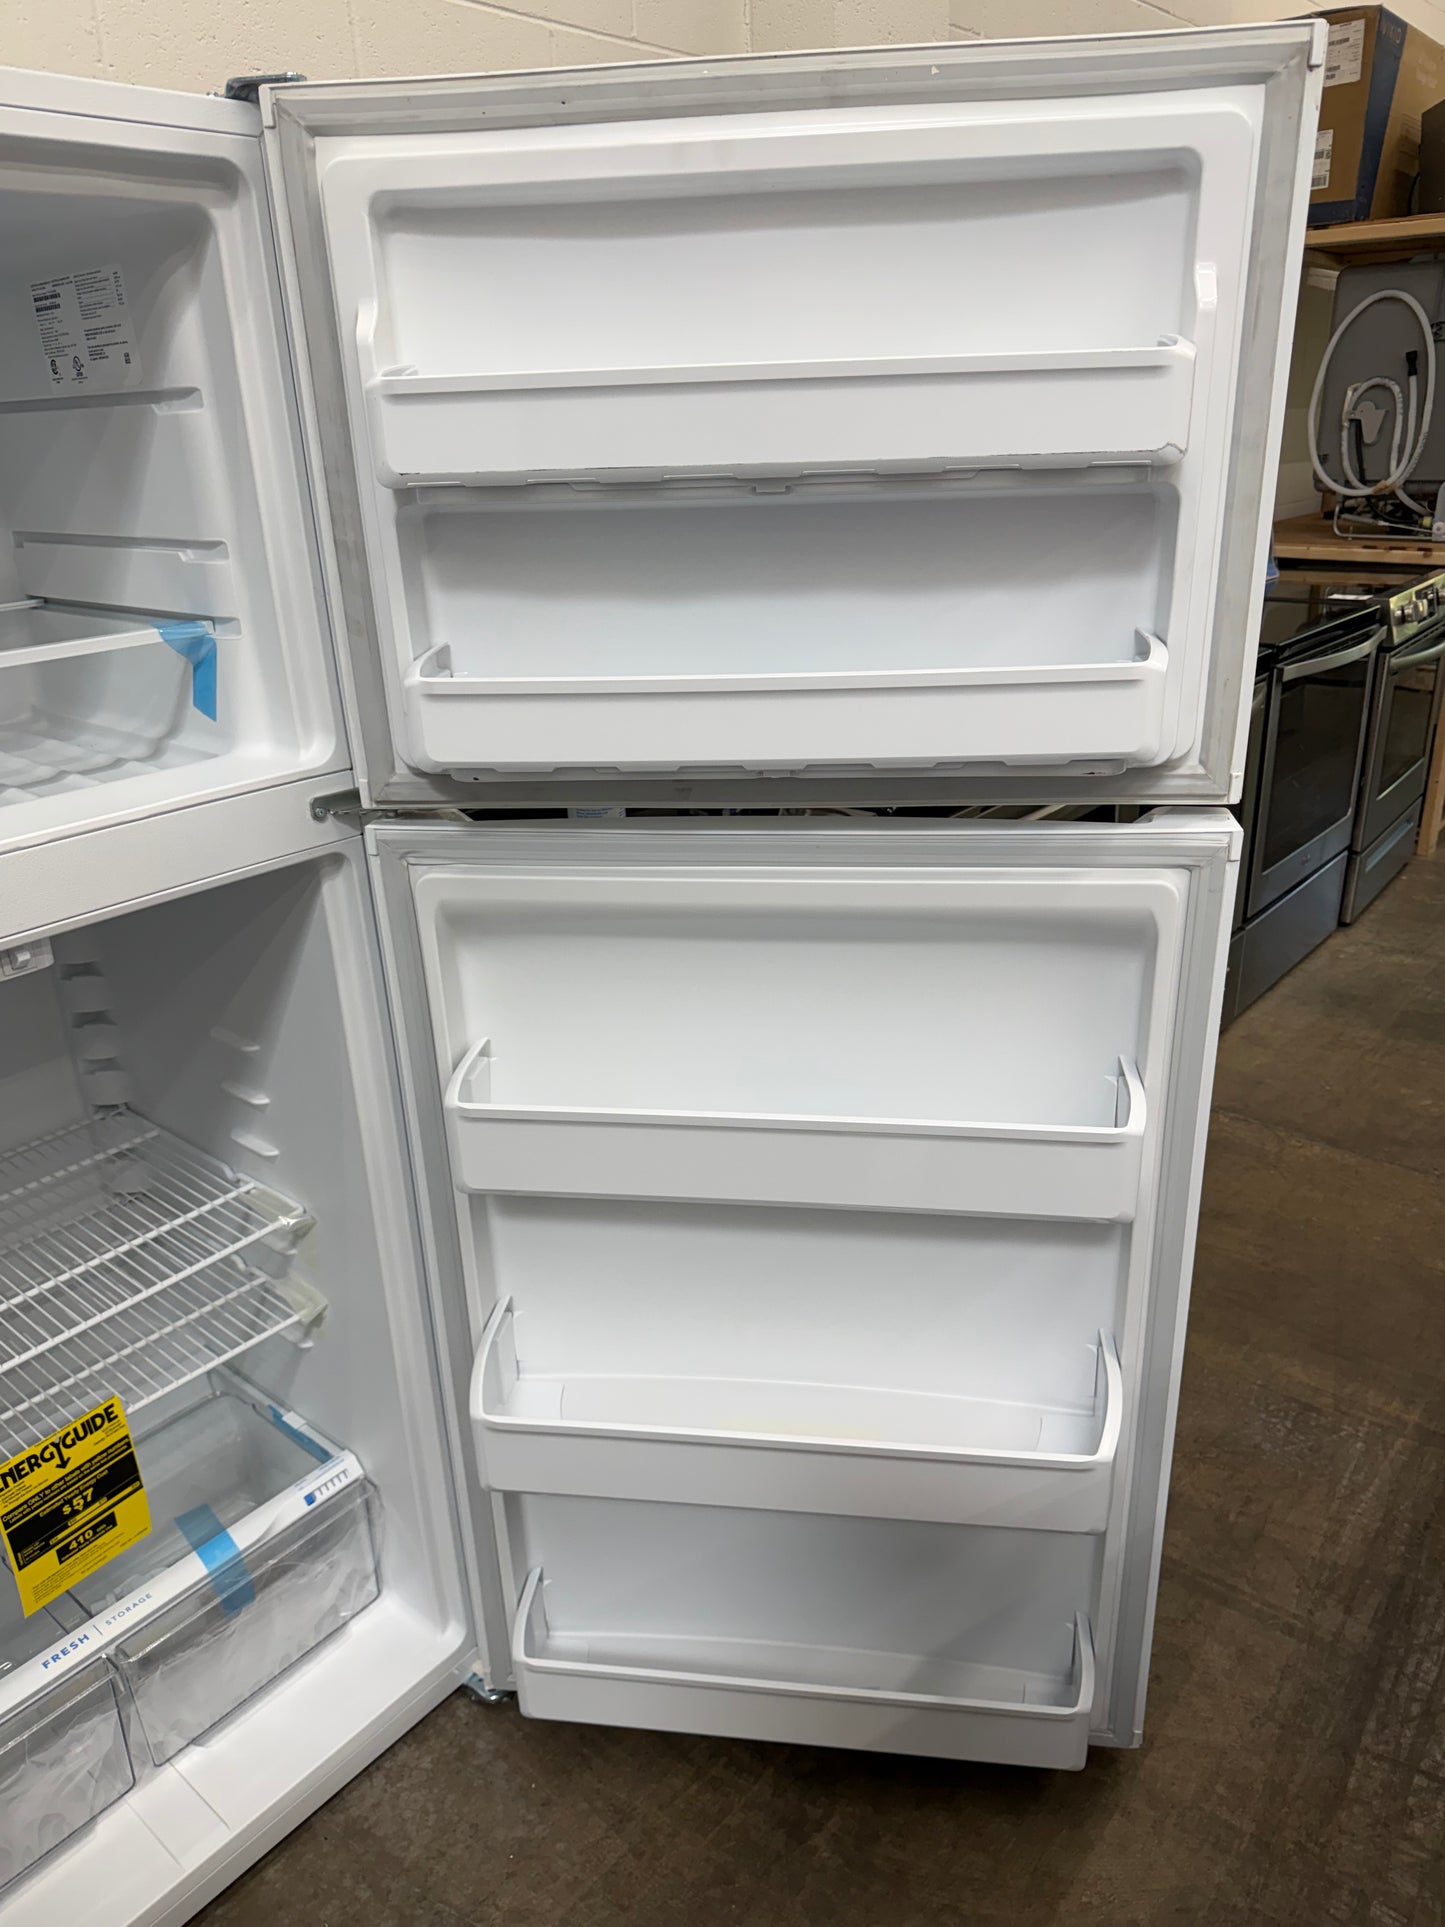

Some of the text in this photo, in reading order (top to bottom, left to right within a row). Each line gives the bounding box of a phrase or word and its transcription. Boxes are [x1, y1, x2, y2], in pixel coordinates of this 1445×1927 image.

[0, 1403, 119, 1492] NERGYGUIDE
[3, 1503, 27, 1523] Compare
[28, 1492, 45, 1506] ONLY
[51, 1479, 64, 1491] other
[65, 1469, 80, 1482] labels
[80, 1462, 91, 1472] with
[91, 1451, 107, 1465] yellow
[39, 1498, 64, 1518] Estimated
[64, 1489, 79, 1501] Yearly
[79, 1477, 97, 1492] Energy
[96, 1469, 108, 1480] Cost
[67, 1528, 94, 1551] 410
[41, 1592, 153, 1669] FRESH STORAGE
